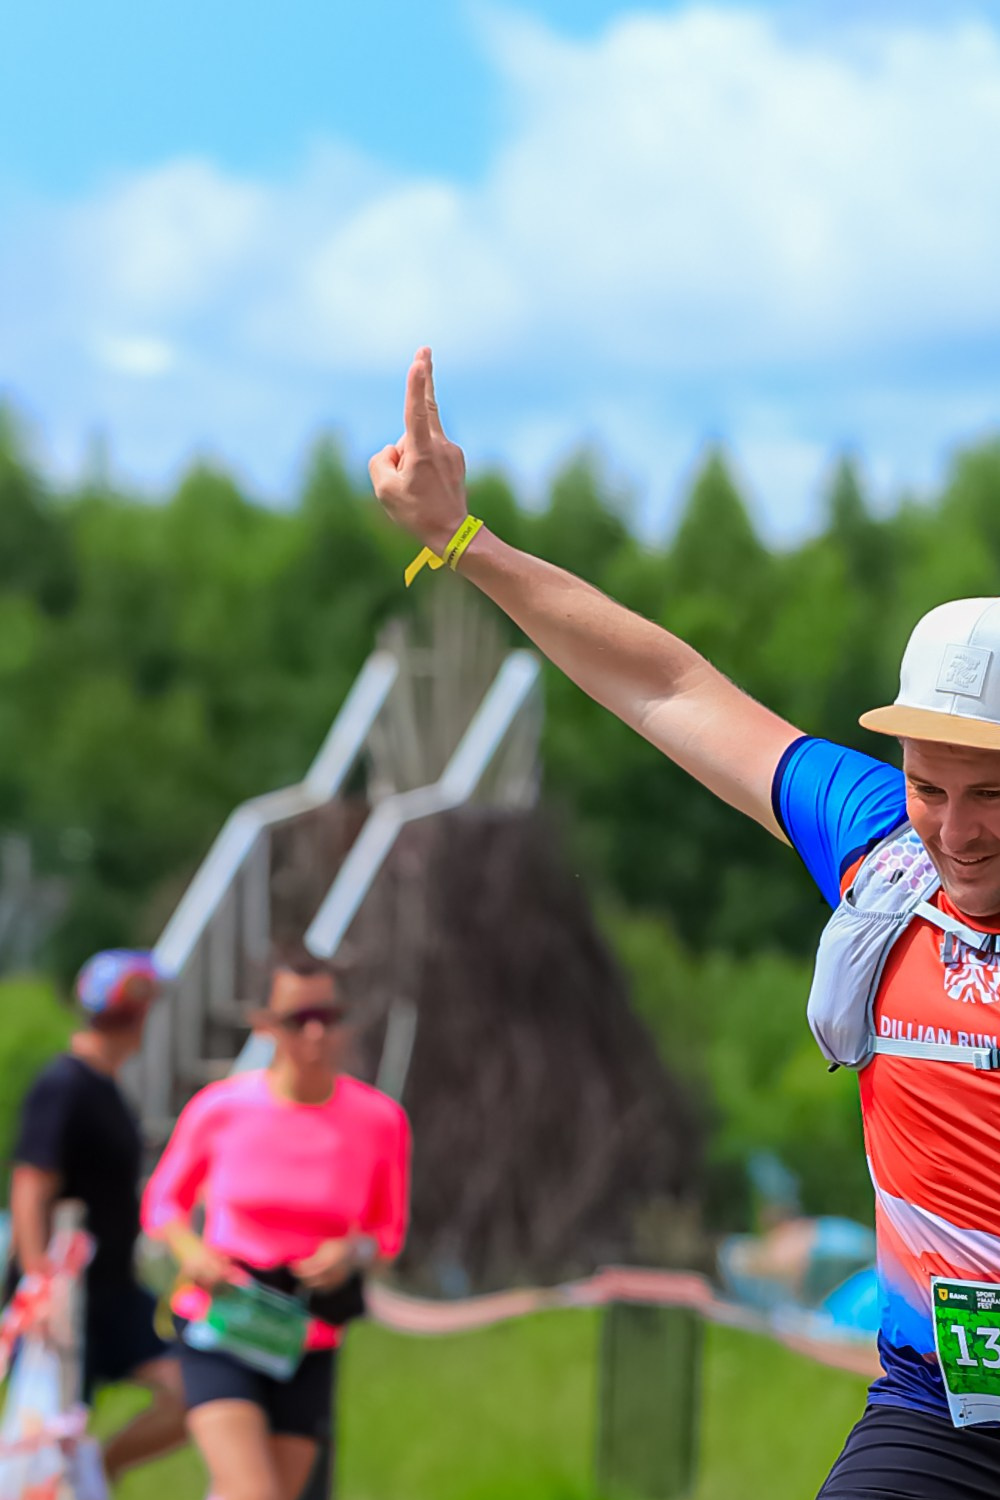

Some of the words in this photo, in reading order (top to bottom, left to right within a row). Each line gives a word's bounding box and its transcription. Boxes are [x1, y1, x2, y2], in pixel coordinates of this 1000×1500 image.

[881, 1014, 951, 1046] DILIJAN
[958, 1031, 997, 1049] RUN
[949, 1292, 968, 1300] BANK
[976, 1291, 996, 1299] SPORT
